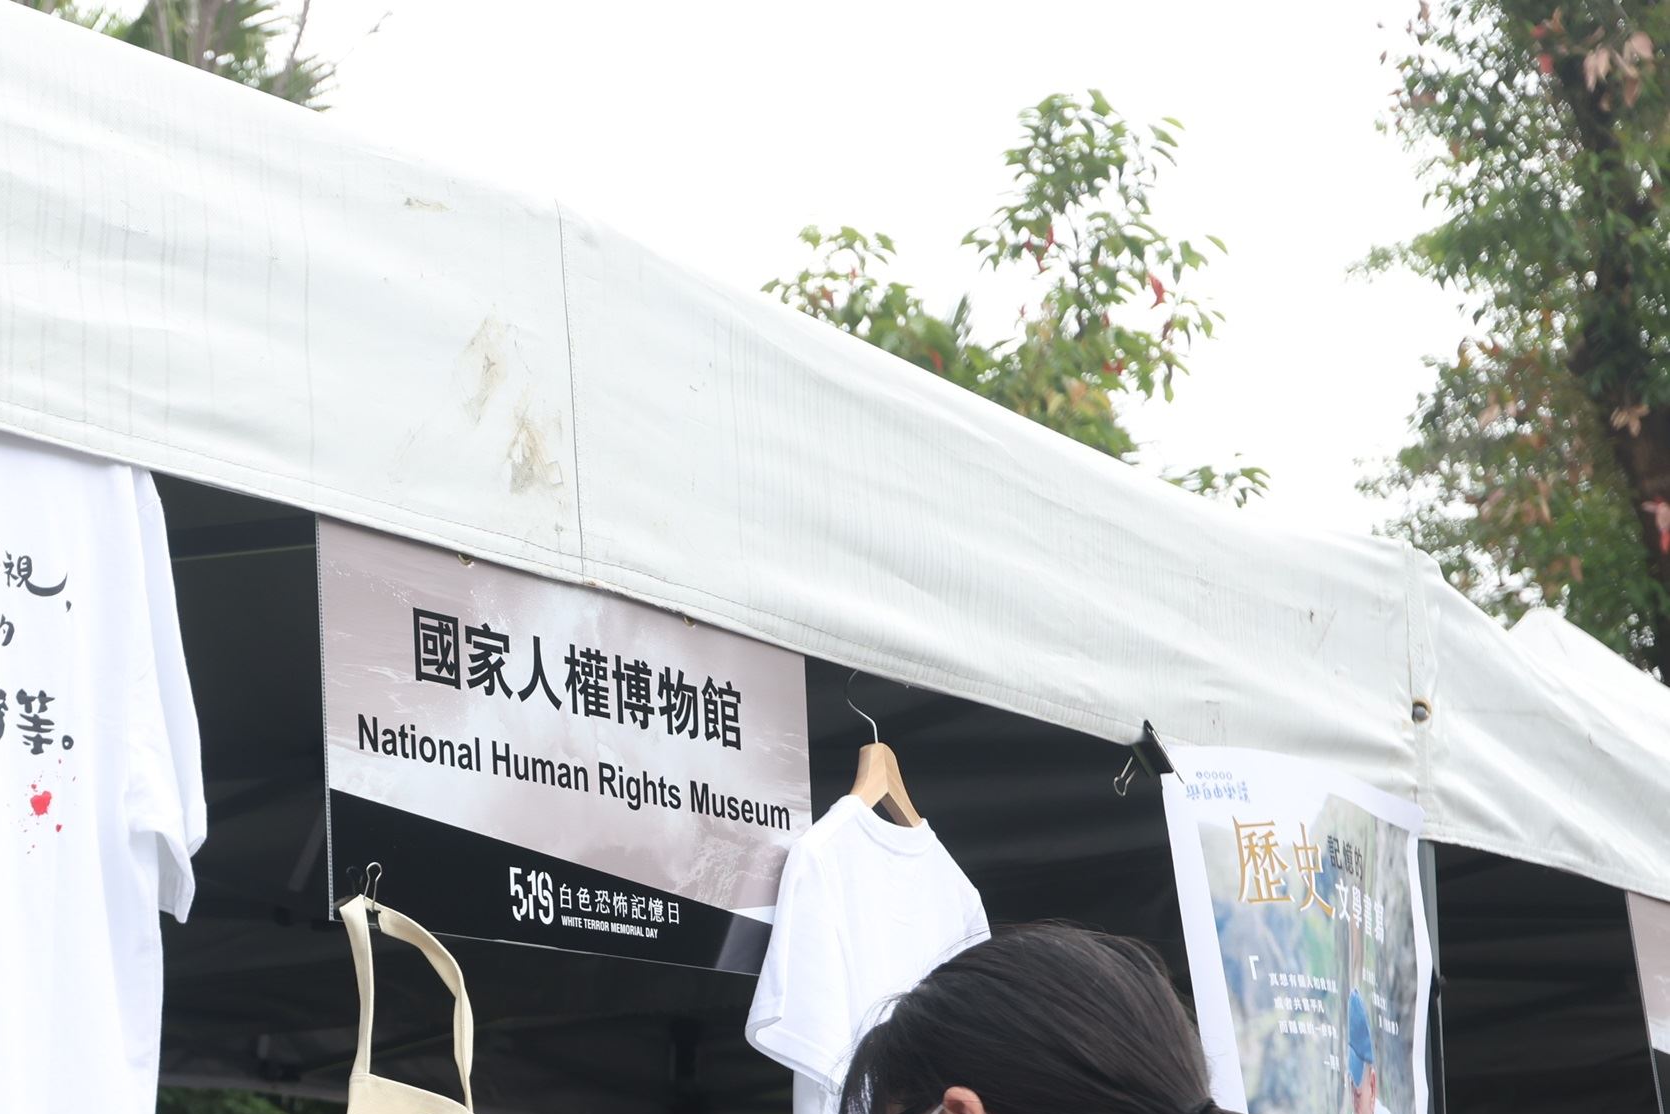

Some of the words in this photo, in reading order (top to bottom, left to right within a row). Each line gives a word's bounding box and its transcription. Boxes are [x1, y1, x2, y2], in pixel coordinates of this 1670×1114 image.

[413, 607, 743, 751] 國家人權博物館
[357, 713, 482, 772] National
[491, 741, 589, 793] Human
[598, 762, 682, 812] Rights
[690, 780, 791, 831] Museum
[1232, 815, 1336, 920] 歷史
[1327, 834, 1363, 881] 記憶的
[509, 866, 555, 926] 519
[559, 883, 681, 925] 白色恐怖記憶日
[561, 915, 583, 929] WHITE
[583, 918, 610, 933] TERROR
[611, 922, 645, 938] MEMORIAL
[645, 928, 658, 939] DAY
[1334, 877, 1385, 945] 文學書寫
